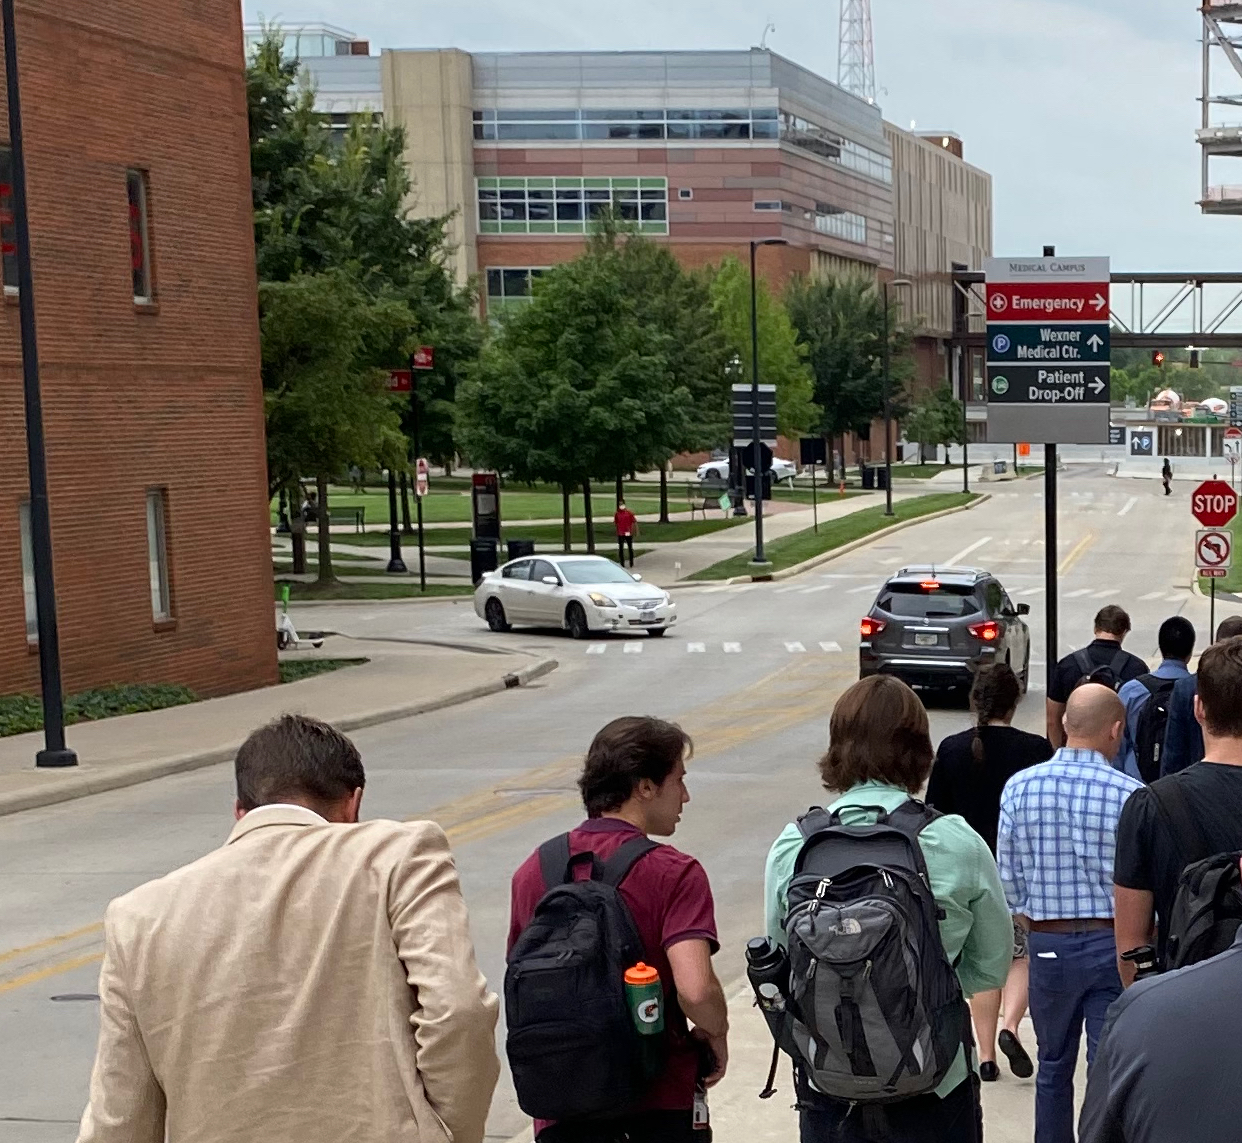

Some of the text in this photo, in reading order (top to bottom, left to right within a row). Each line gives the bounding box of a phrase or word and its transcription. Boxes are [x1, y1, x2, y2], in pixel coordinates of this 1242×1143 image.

[1012, 295, 1085, 313] Emergency
[1040, 328, 1081, 342] Wexner
[1017, 345, 1081, 359] Medical Ctr.
[1038, 370, 1085, 384] Patient
[1028, 386, 1085, 403] Drop-Off
[1194, 494, 1236, 513] STOP
